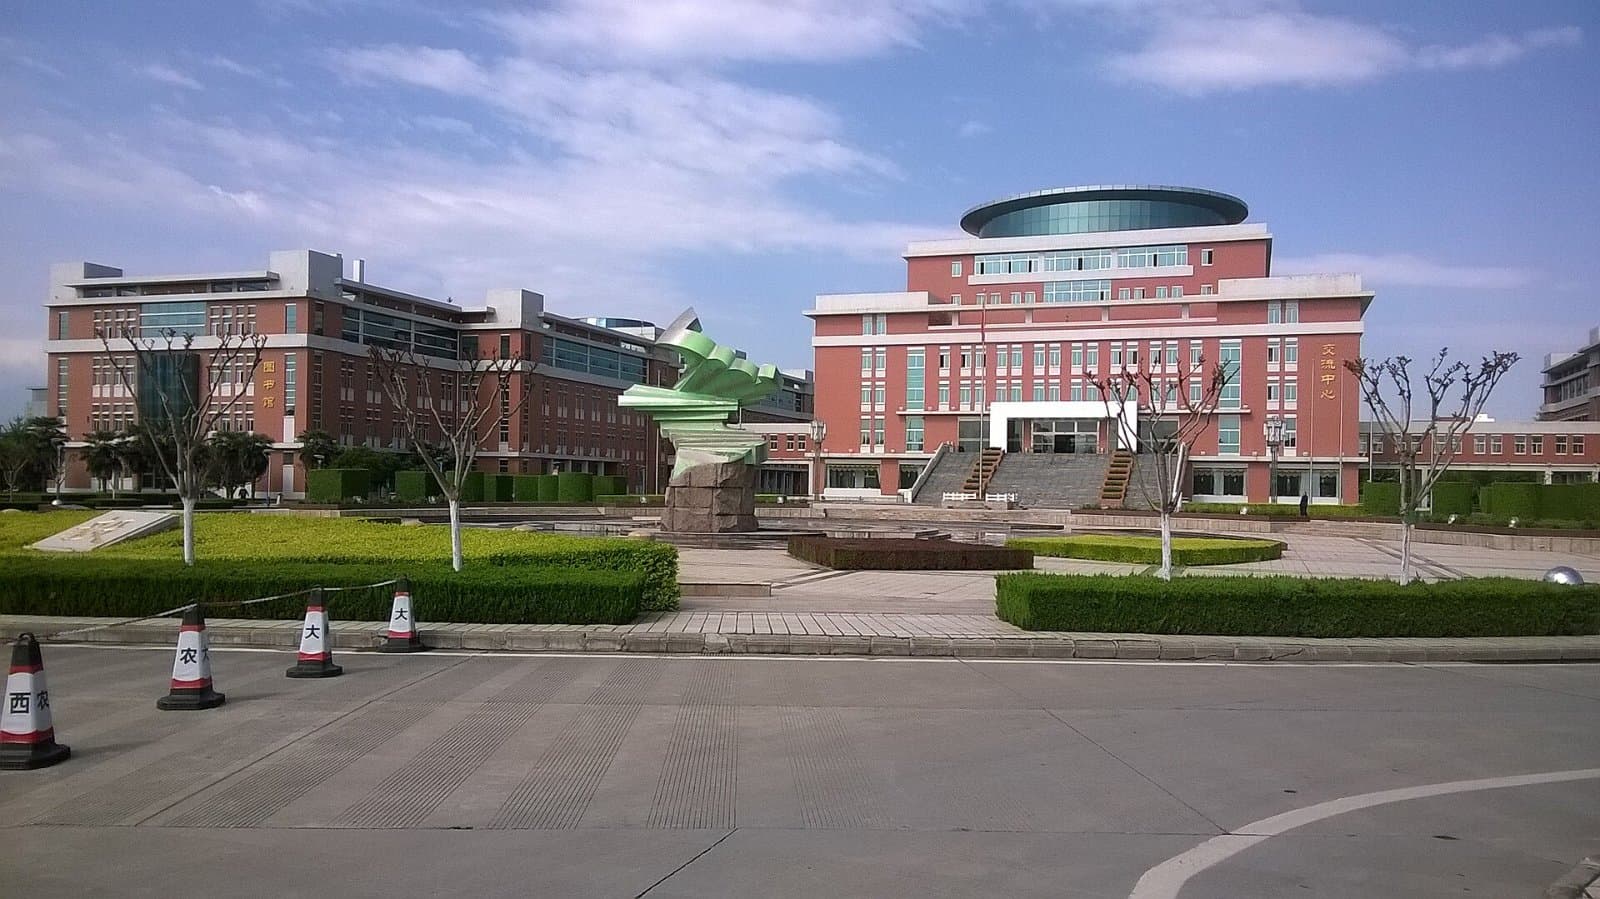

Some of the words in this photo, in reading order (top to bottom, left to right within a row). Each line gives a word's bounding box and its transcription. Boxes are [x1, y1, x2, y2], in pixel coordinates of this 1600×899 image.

[1321, 343, 1336, 400] 交流中心
[394, 608, 408, 620] 大
[305, 624, 320, 639] 大
[180, 647, 197, 665] 农
[9, 692, 31, 714] 西
